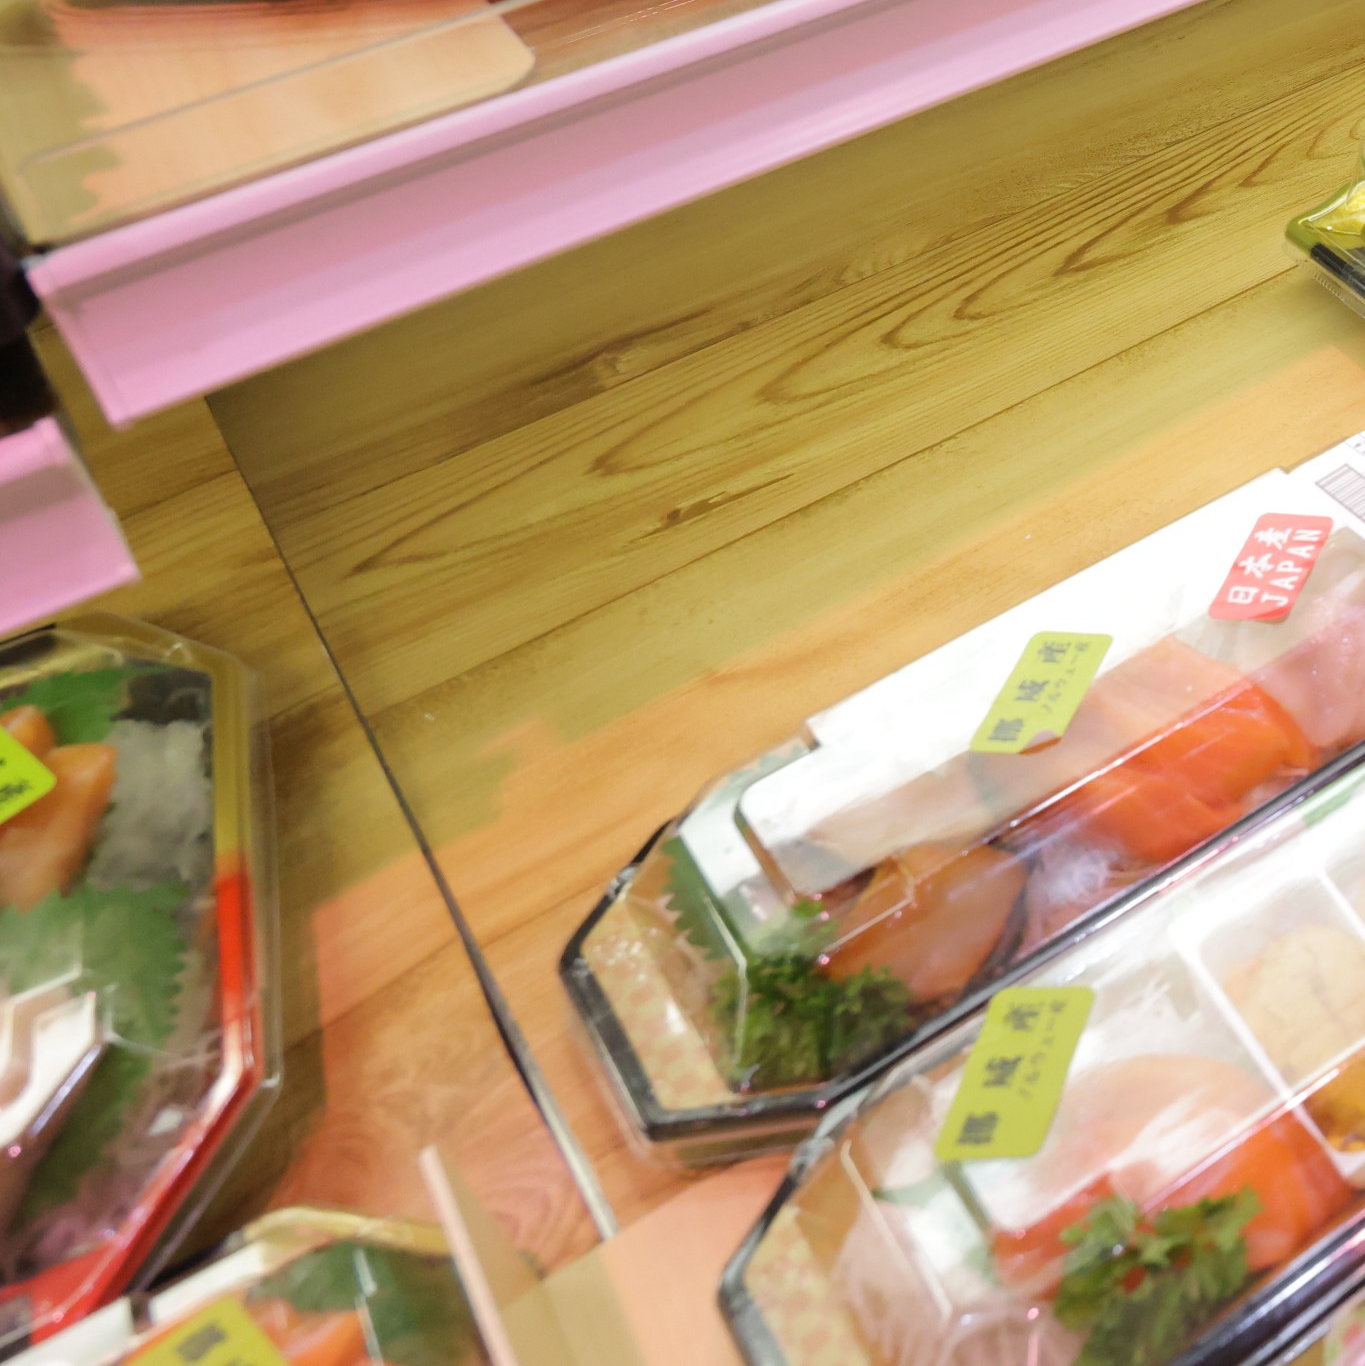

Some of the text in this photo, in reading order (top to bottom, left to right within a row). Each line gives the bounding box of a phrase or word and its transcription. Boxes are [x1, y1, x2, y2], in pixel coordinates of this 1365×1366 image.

[1228, 527, 1293, 605] 日本産
[1261, 529, 1322, 607] JAPAN
